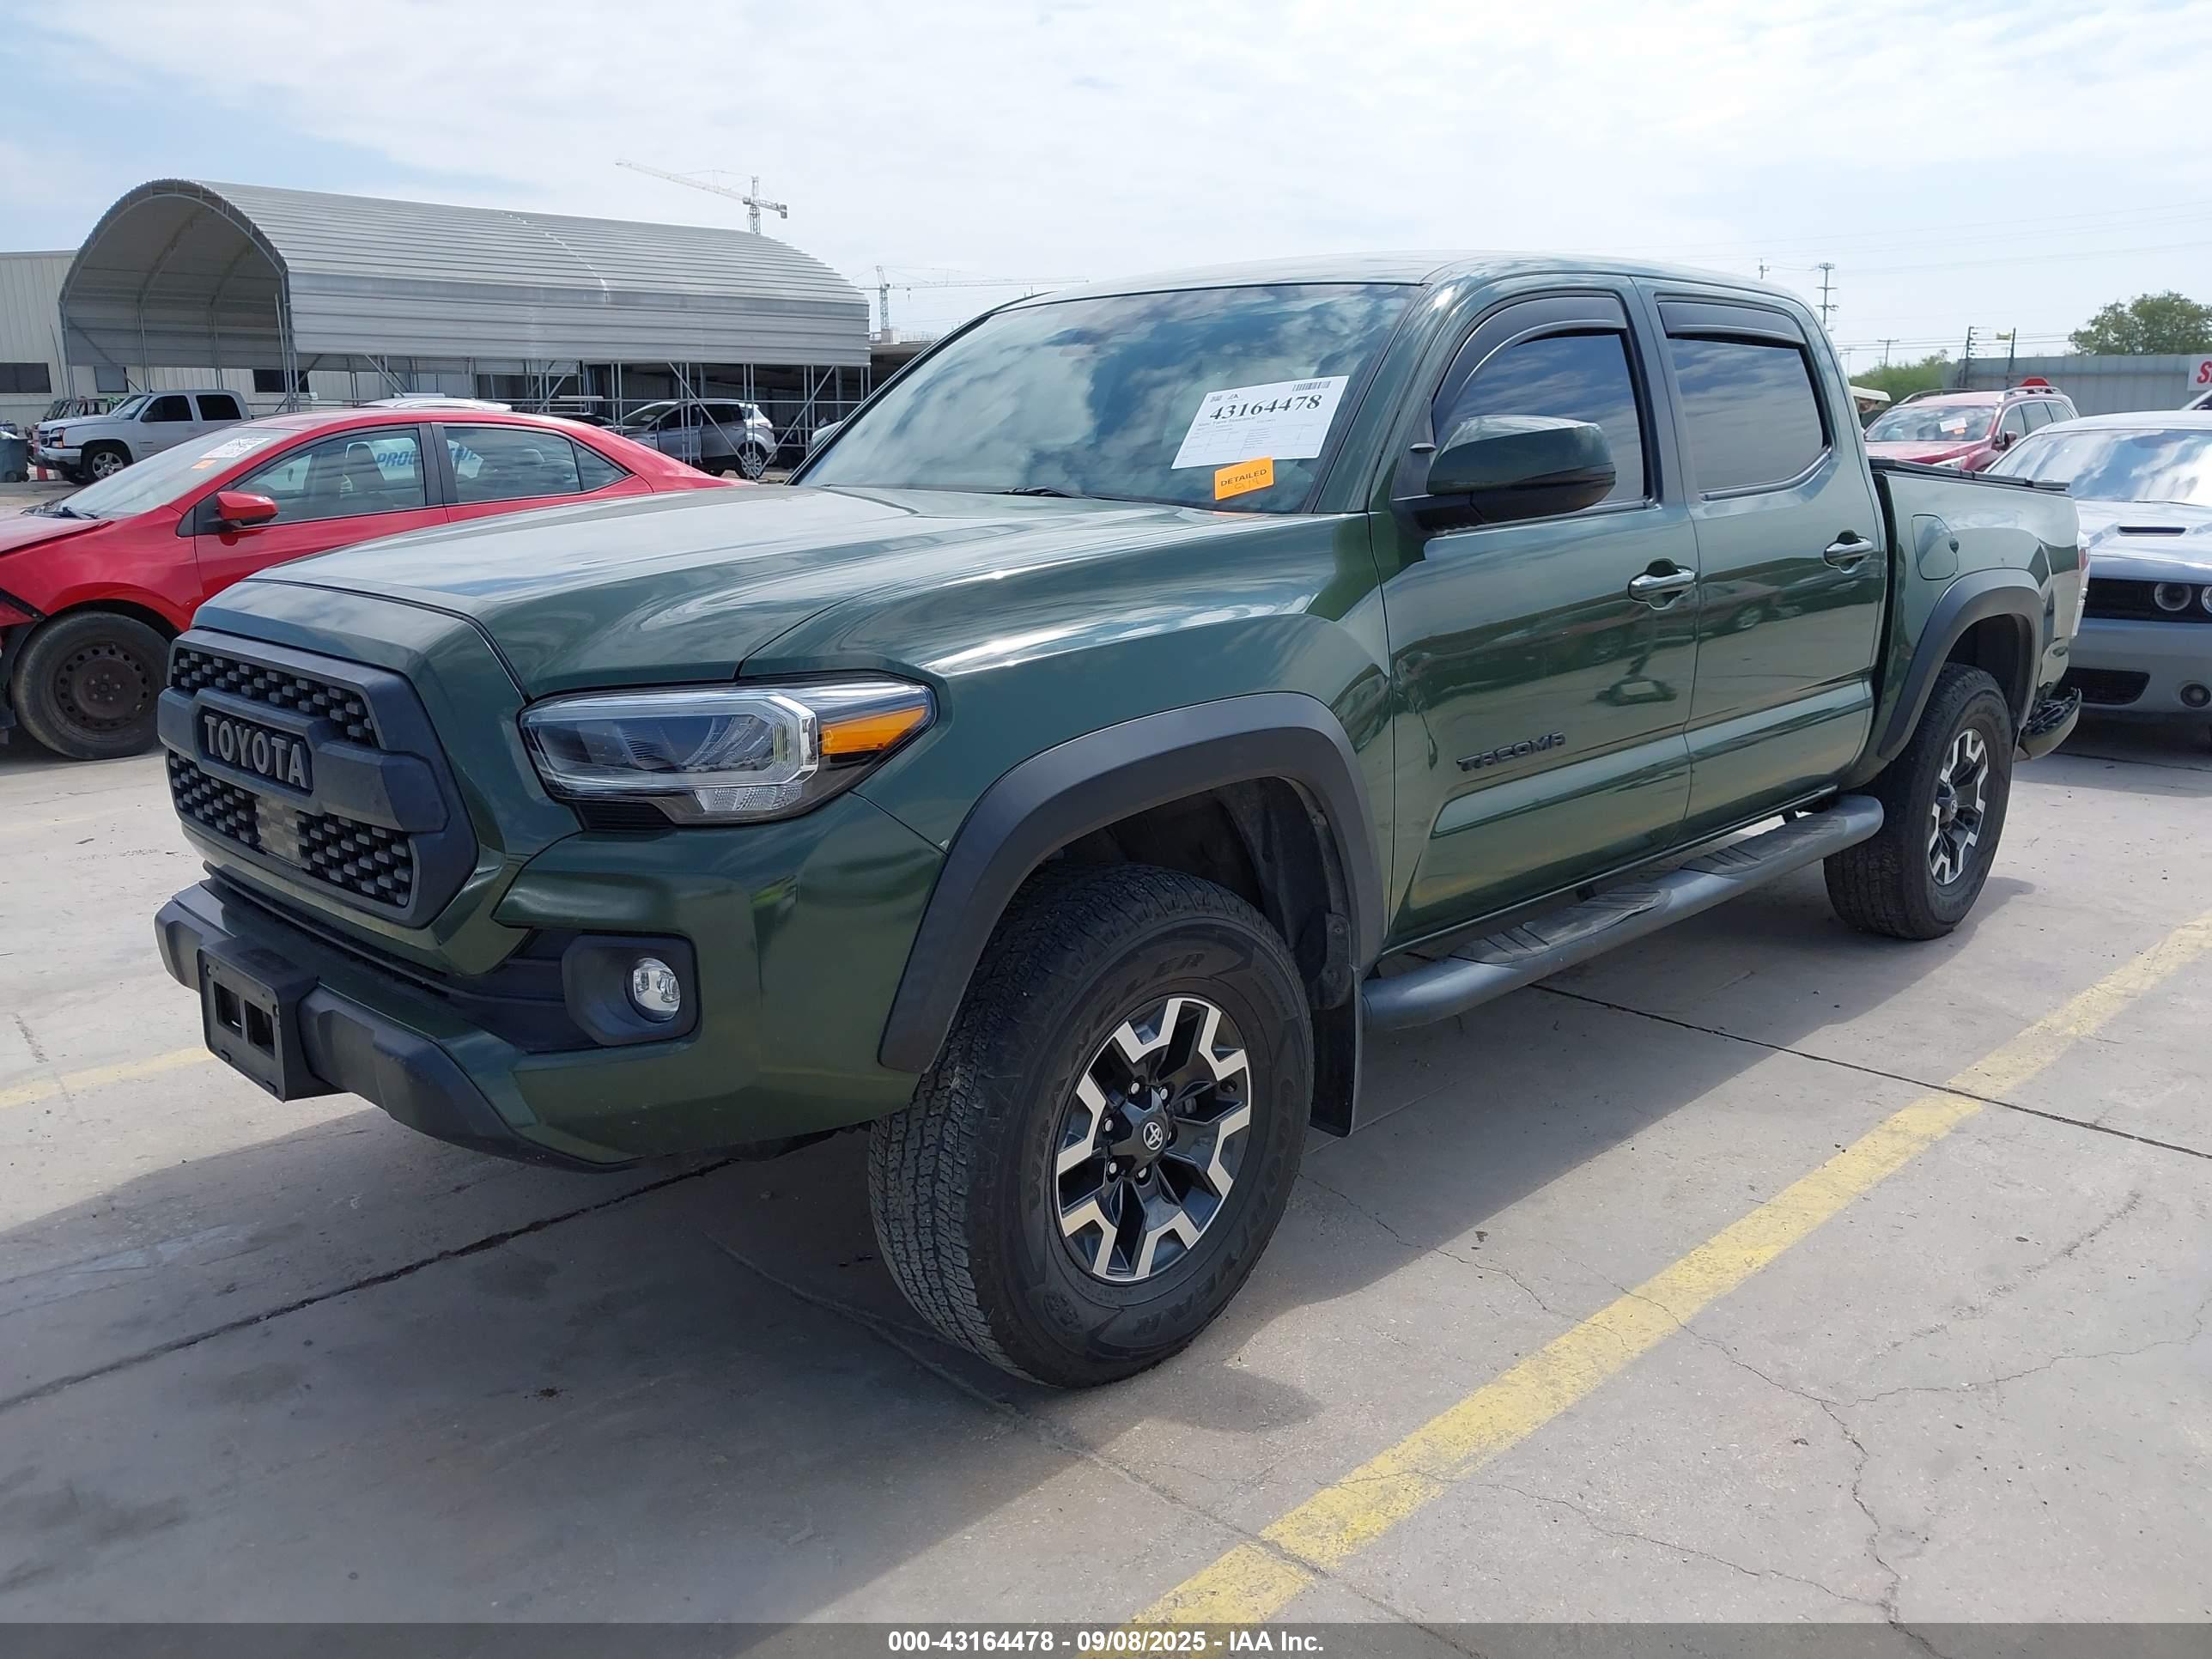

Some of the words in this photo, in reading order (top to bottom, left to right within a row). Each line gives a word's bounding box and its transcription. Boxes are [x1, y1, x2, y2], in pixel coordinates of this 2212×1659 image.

[1210, 395, 1322, 419] 43164478
[1220, 469, 1267, 487] DETAILED
[204, 714, 308, 789] TOYOTA
[1457, 731, 1565, 771] TACOMA
